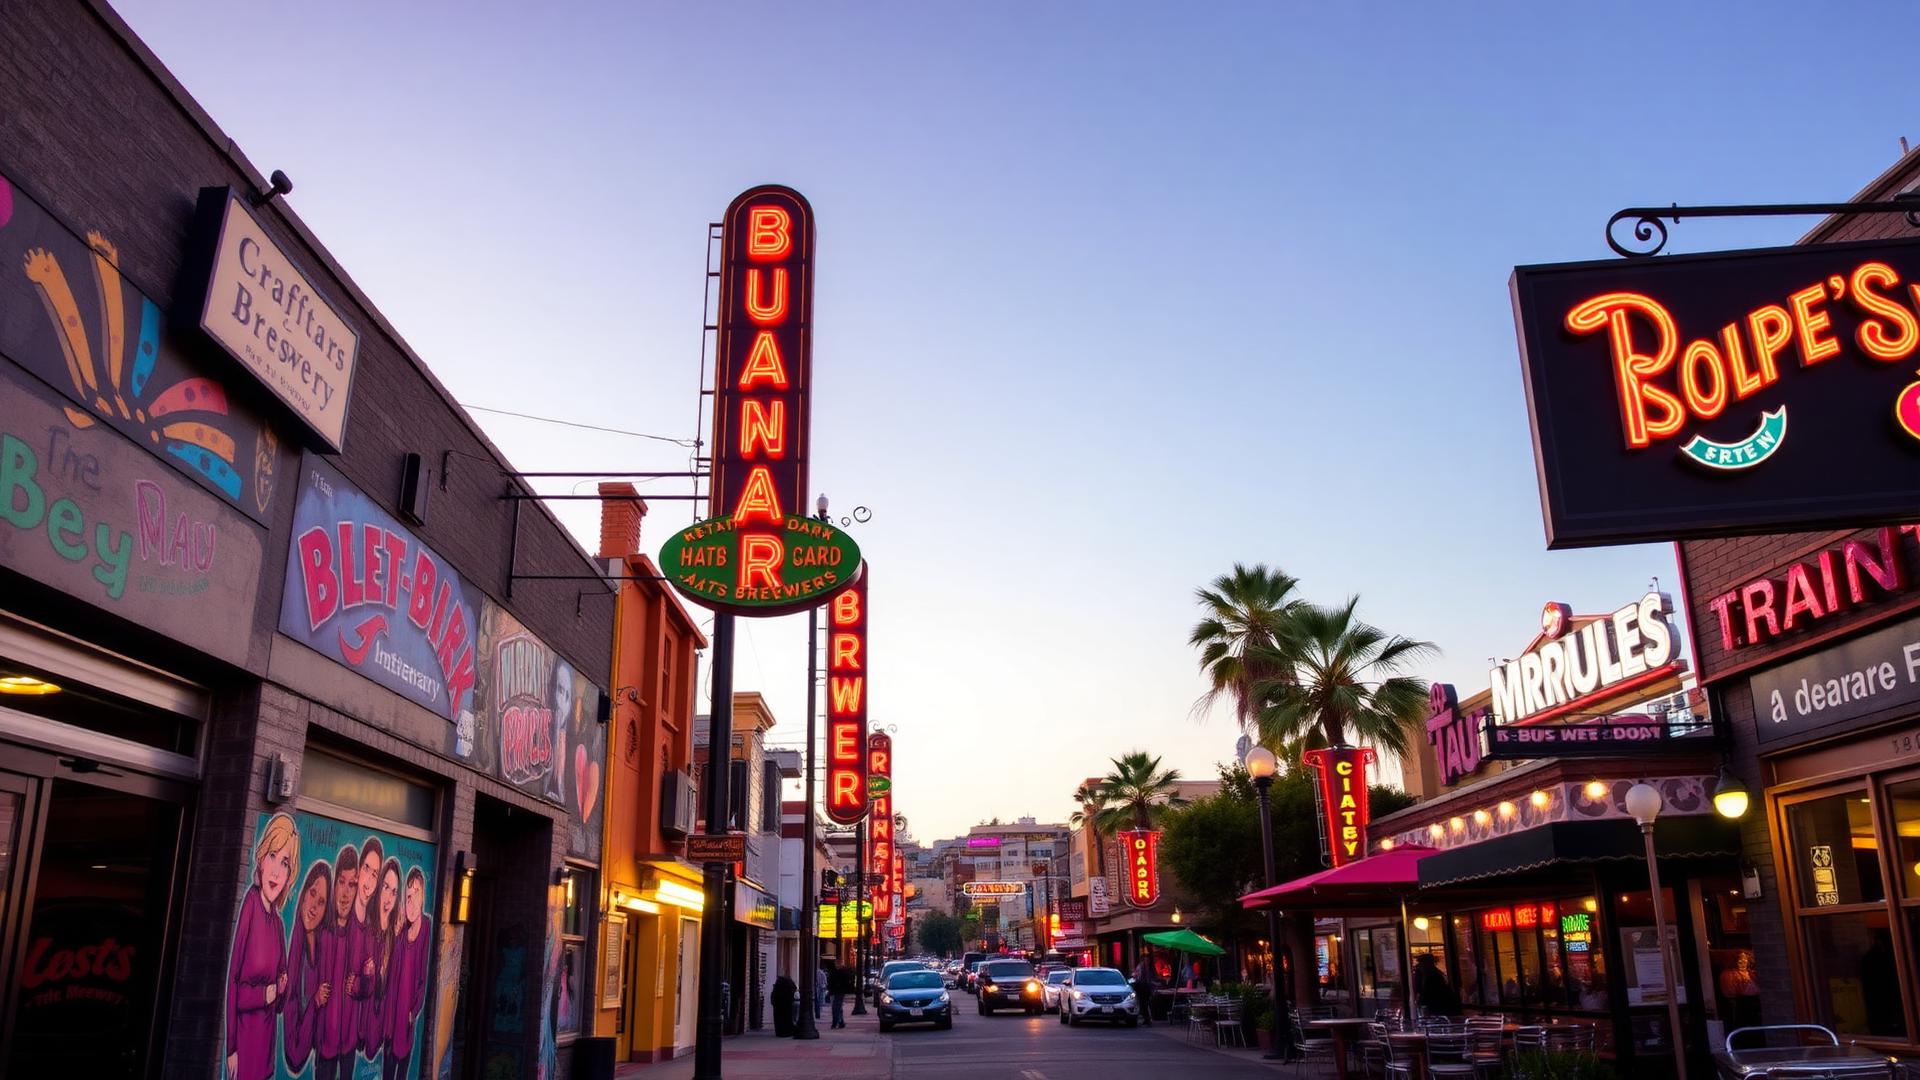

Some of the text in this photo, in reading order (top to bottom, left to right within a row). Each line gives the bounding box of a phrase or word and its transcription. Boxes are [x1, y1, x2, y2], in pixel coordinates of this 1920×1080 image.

[239, 237, 346, 372] Crafftars
[733, 205, 793, 592] BUANAR
[0, 433, 133, 600] Bey
[832, 589, 863, 806] BRWER
[1771, 690, 1788, 722] a
[1795, 662, 1896, 715] dearare
